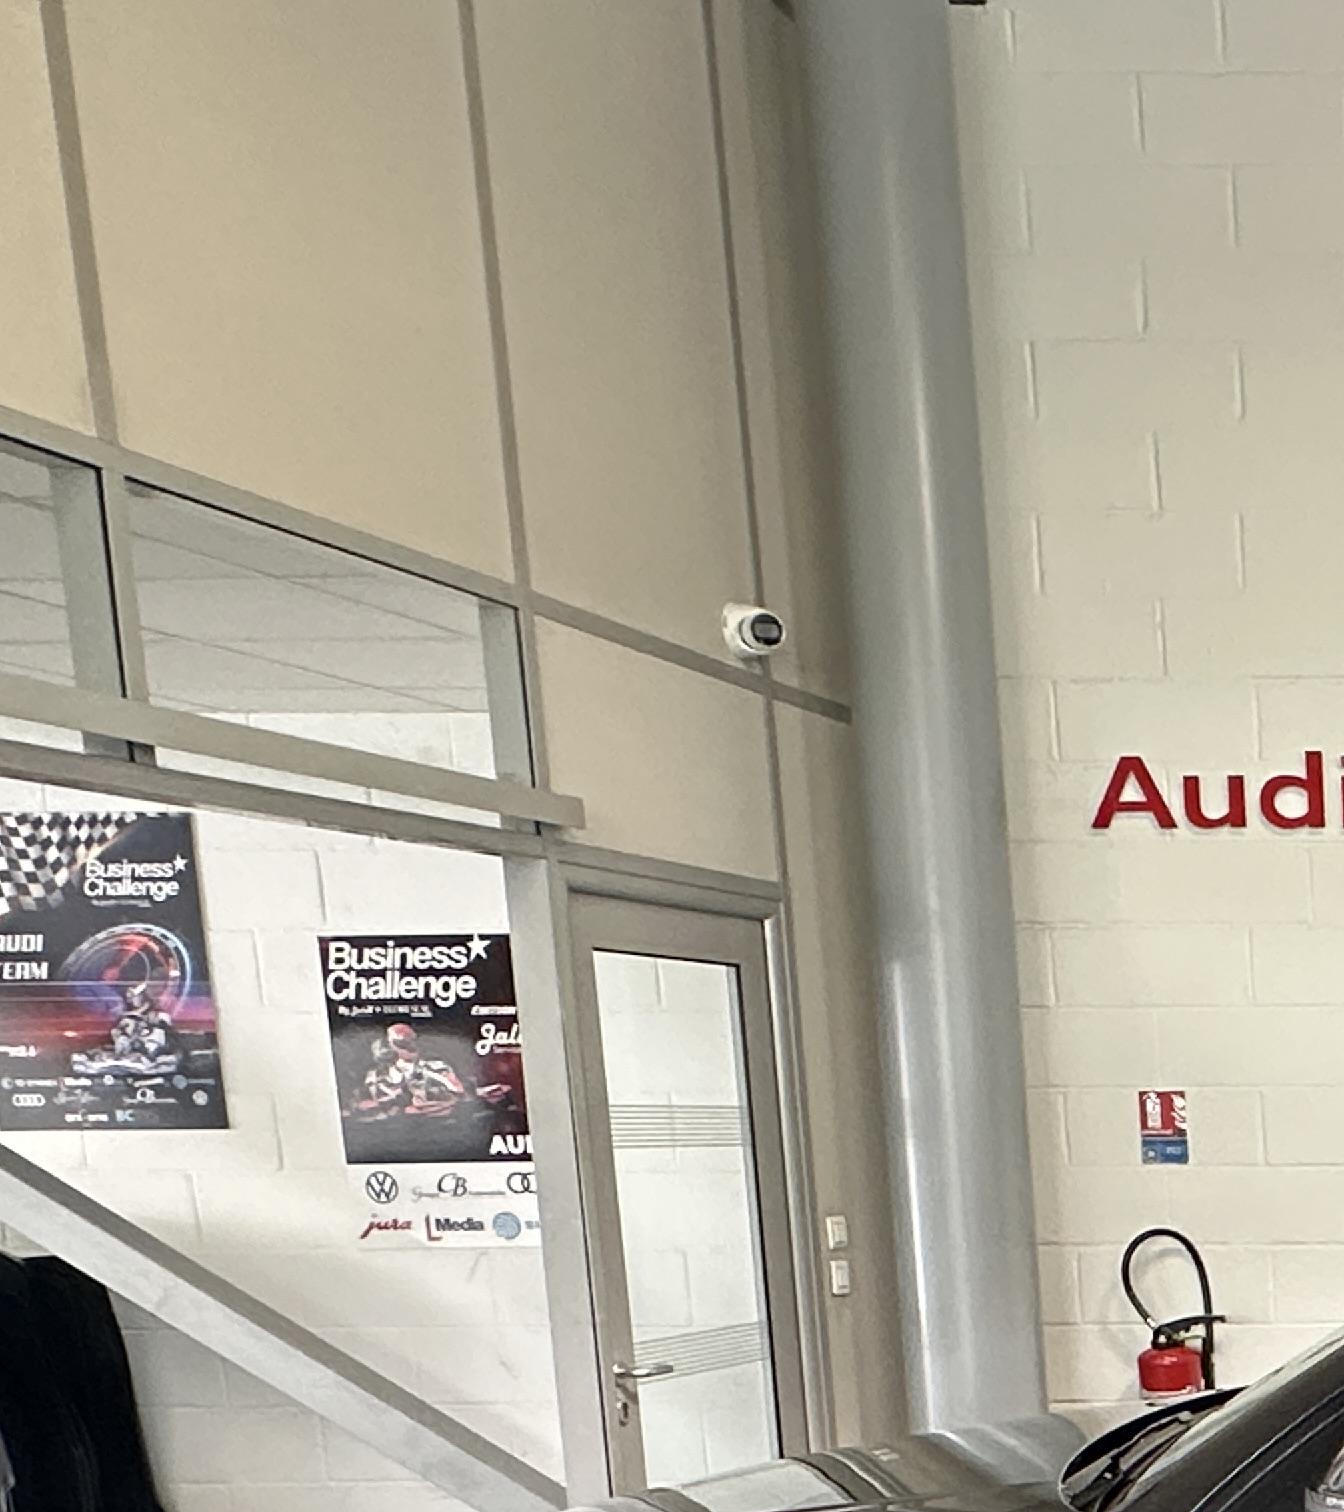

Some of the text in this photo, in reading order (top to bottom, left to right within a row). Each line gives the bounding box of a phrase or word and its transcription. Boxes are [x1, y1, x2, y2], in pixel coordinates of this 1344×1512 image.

[85, 858, 174, 878] Business
[83, 878, 180, 902] Challenge
[327, 940, 468, 970] Business
[326, 970, 477, 1008] Challenge
